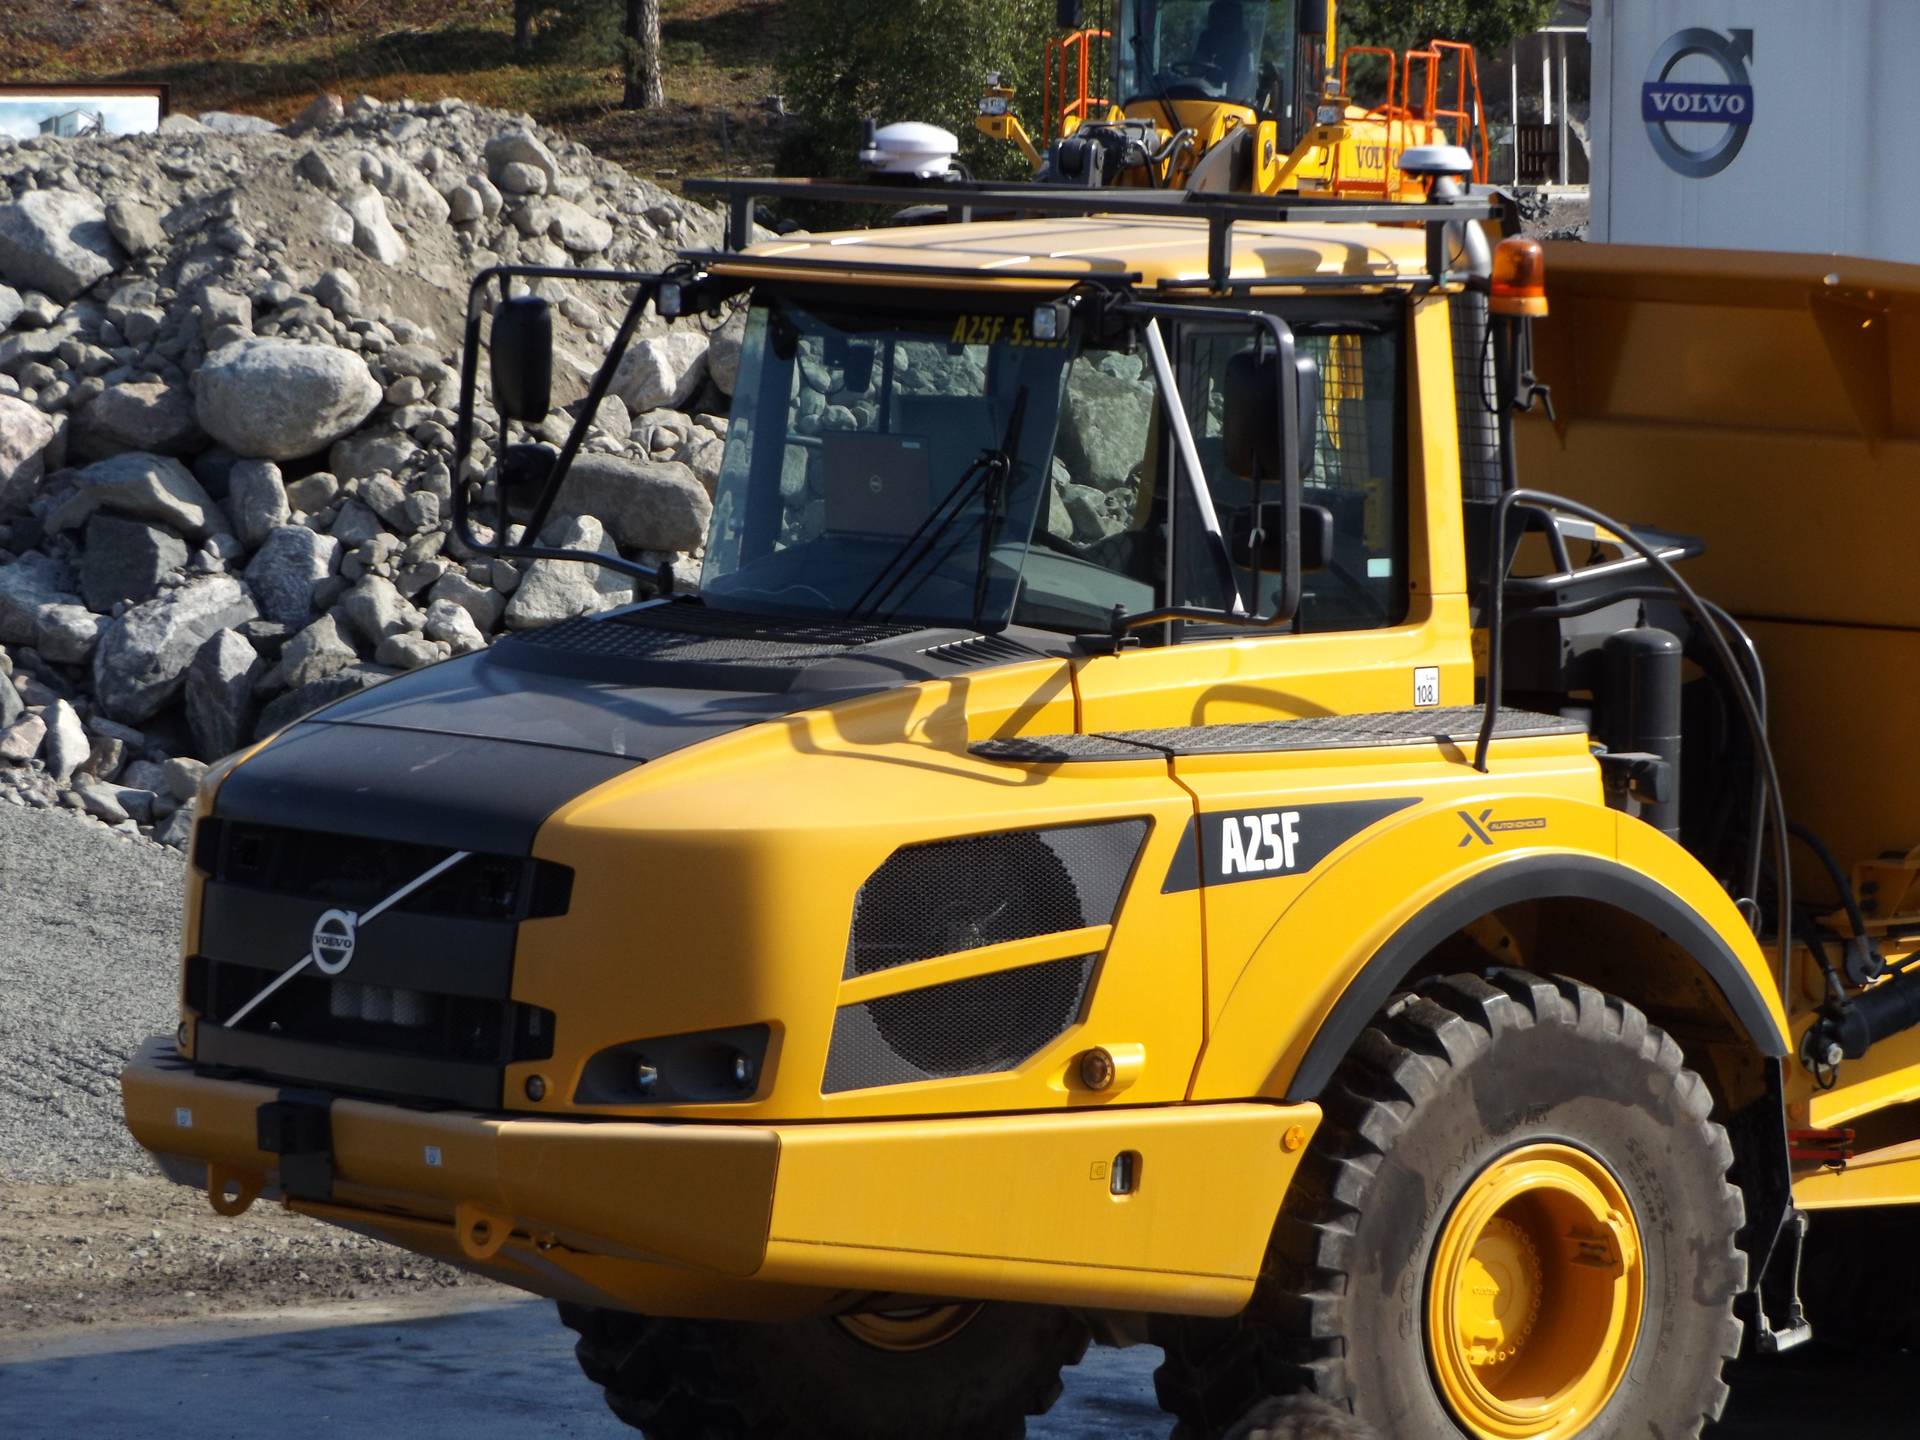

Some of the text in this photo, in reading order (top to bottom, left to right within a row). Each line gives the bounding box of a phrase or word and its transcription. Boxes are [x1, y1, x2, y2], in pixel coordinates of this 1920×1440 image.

[1649, 92, 1745, 114] VOLVO
[951, 315, 1005, 344] A25F
[1417, 684, 1433, 703] 108
[1222, 811, 1300, 875] A25F
[315, 935, 353, 949] VOLVO
